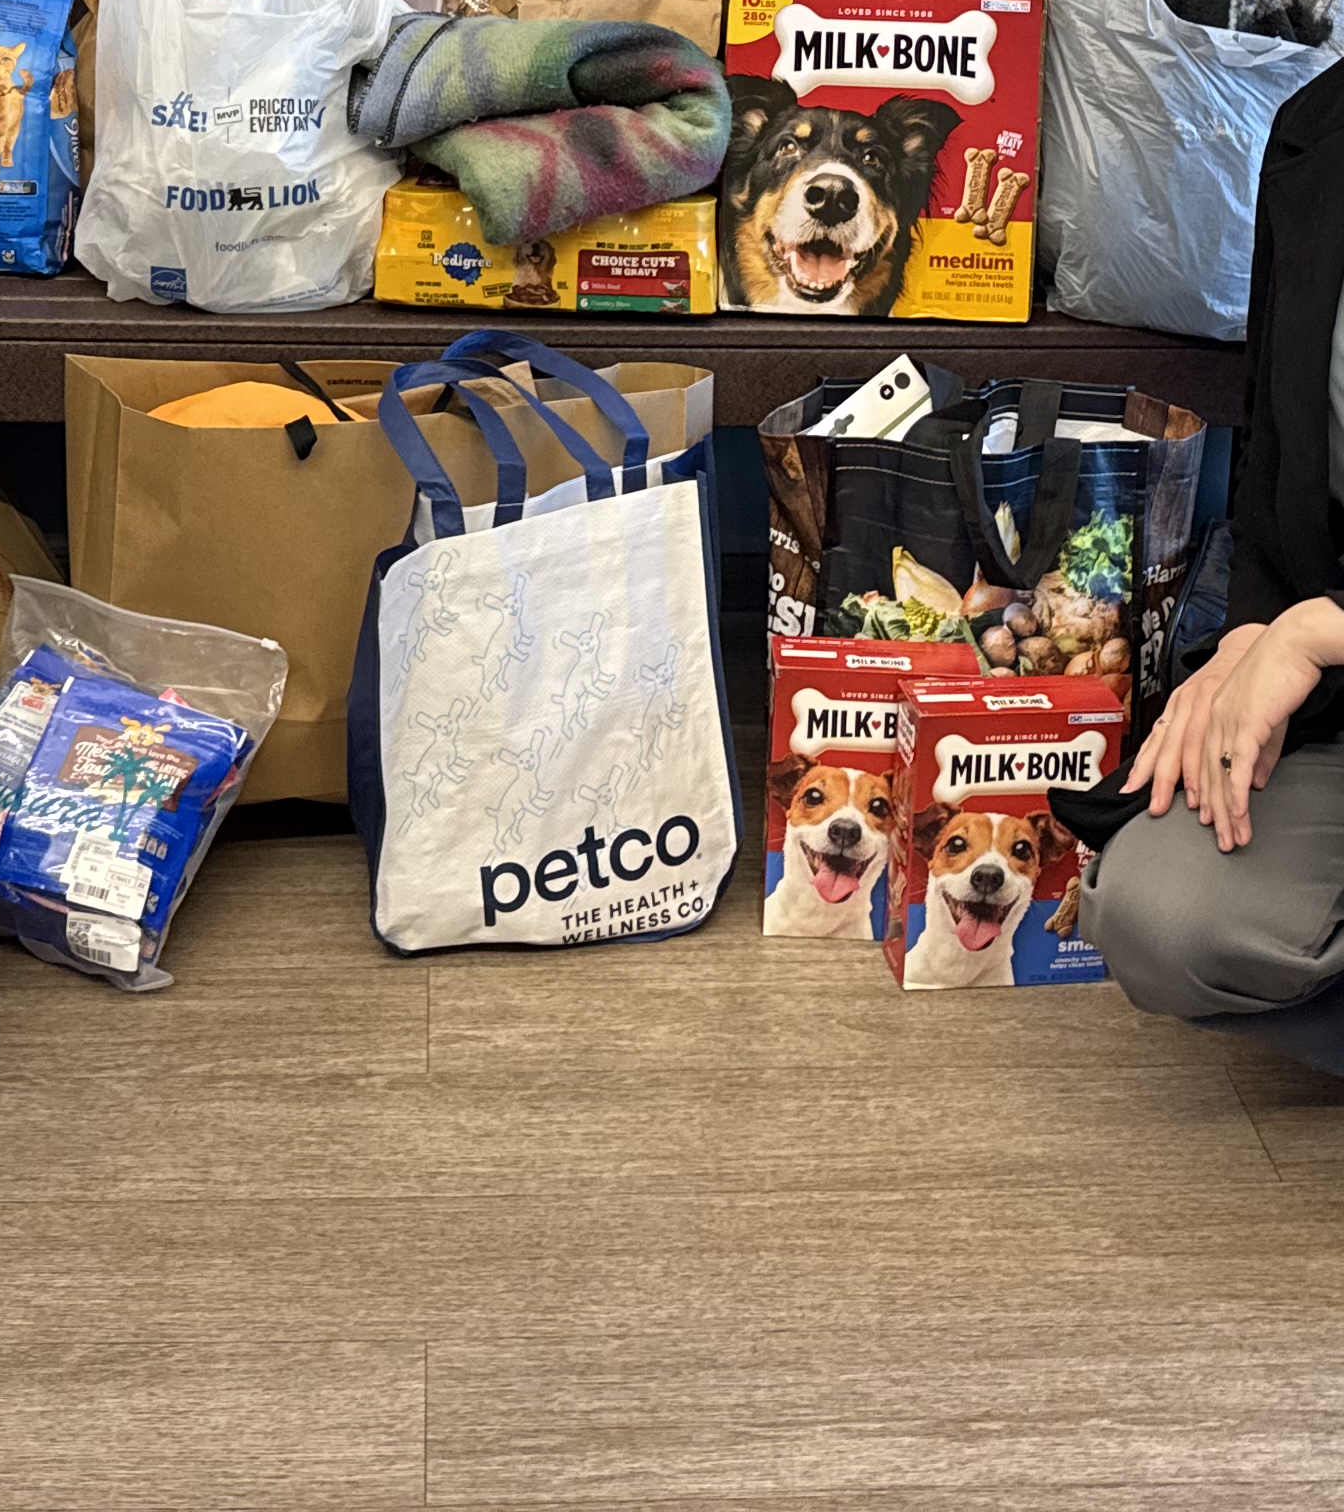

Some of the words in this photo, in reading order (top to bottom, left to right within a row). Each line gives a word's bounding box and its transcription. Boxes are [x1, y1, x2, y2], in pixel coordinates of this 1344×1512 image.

[761, 0, 777, 8] LBS
[837, 8, 871, 17] LOVED
[875, 9, 906, 18] SINCE
[742, 11, 773, 21] 280+
[793, 30, 879, 72] MILK
[892, 33, 978, 79] BONE
[216, 110, 240, 120] MVP
[249, 98, 295, 116] PRICED
[249, 115, 290, 133] EVERY
[166, 185, 225, 212] FOOD
[268, 178, 320, 209] LION
[433, 252, 493, 270] Pedigree
[591, 254, 639, 267] CHOICE
[641, 256, 676, 268] CUTS
[928, 253, 1014, 271] medium
[610, 267, 622, 276] IN
[623, 268, 658, 277] GRAVY
[326, 378, 383, 386] carhartt.com
[768, 527, 801, 555] rris
[806, 707, 874, 740] MILK
[950, 753, 1017, 787] MILK
[1026, 750, 1093, 783] BONE
[480, 814, 700, 928] petco
[560, 907, 602, 931] THE
[608, 880, 685, 919] HEALTH
[562, 909, 672, 946] WELLNESS
[1057, 940, 1095, 953] sma
